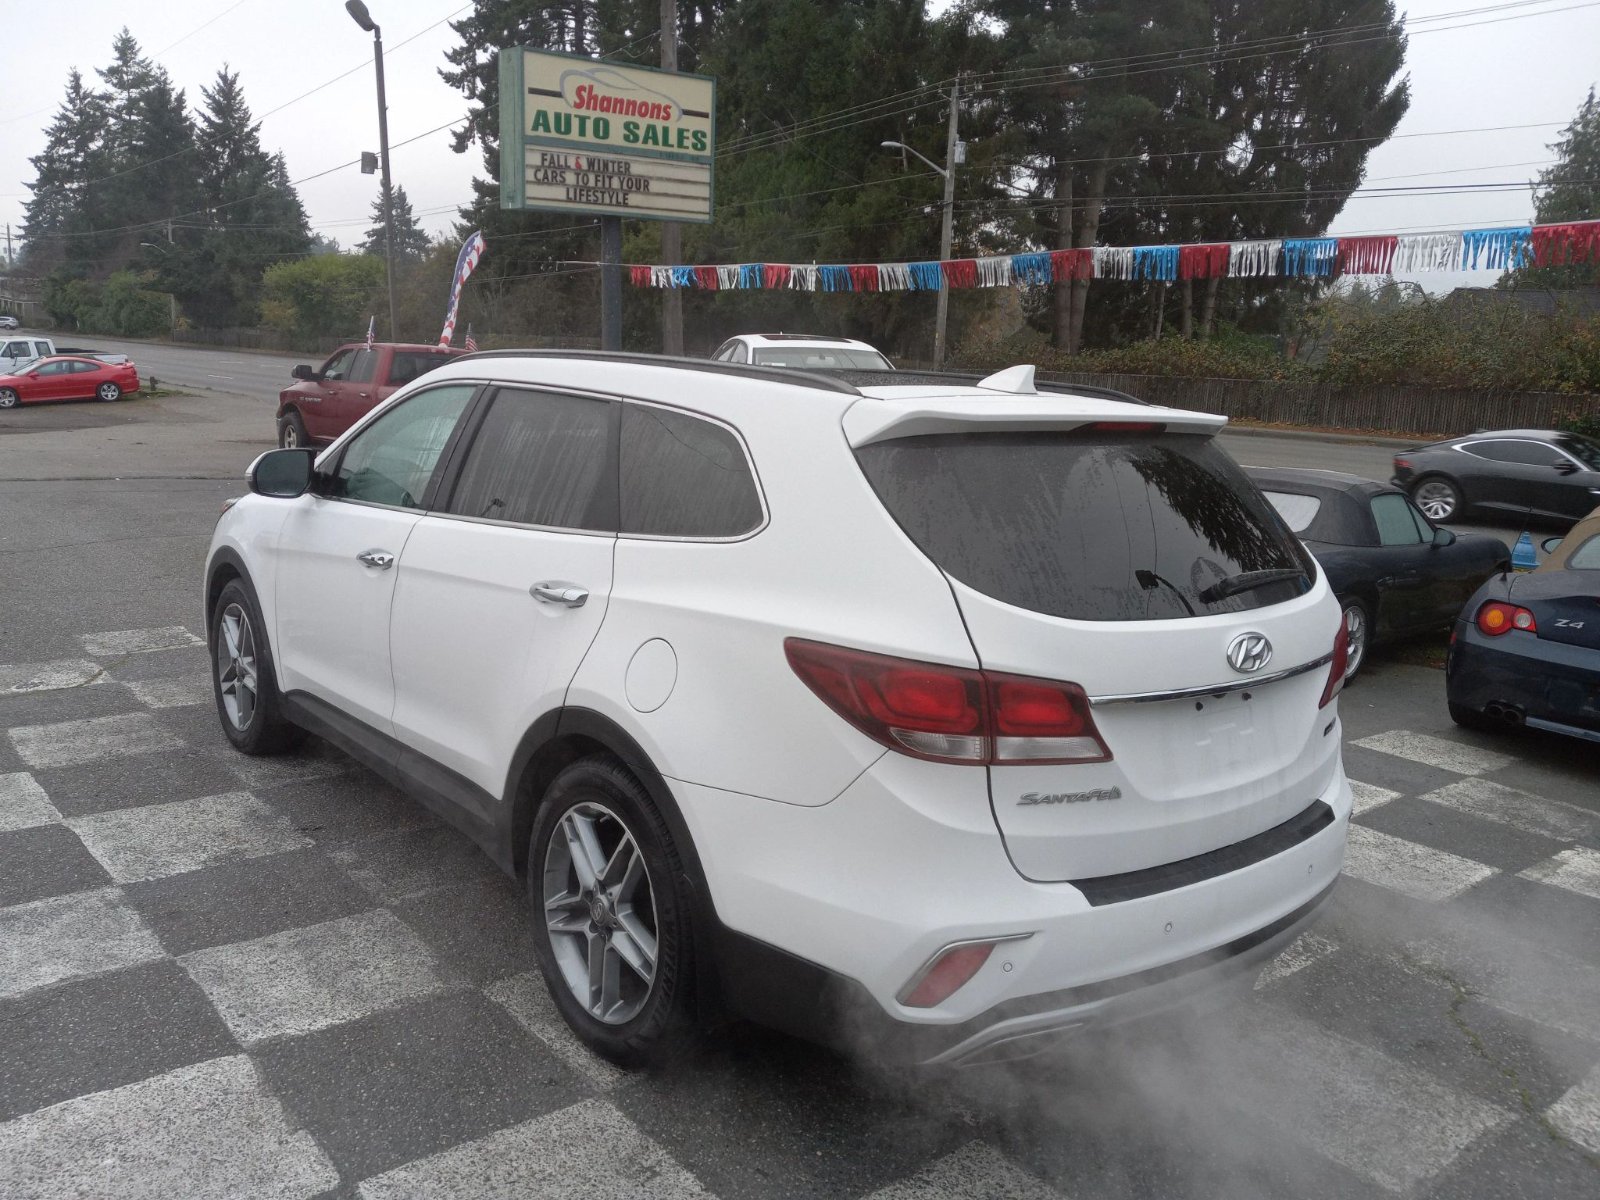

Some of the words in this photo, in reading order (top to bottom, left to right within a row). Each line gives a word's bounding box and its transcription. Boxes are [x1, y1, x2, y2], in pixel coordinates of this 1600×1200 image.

[573, 84, 672, 121] Shannons
[531, 109, 610, 140] AUTO
[623, 121, 707, 151] SALES
[541, 152, 571, 168] FALL
[587, 159, 631, 175] WINTER
[534, 169, 566, 184] CARS
[575, 172, 590, 186] TO
[595, 175, 614, 189] FIT
[618, 176, 650, 192] YOUR
[566, 188, 629, 206] LIFESTYLE
[1554, 618, 1585, 630] Z4
